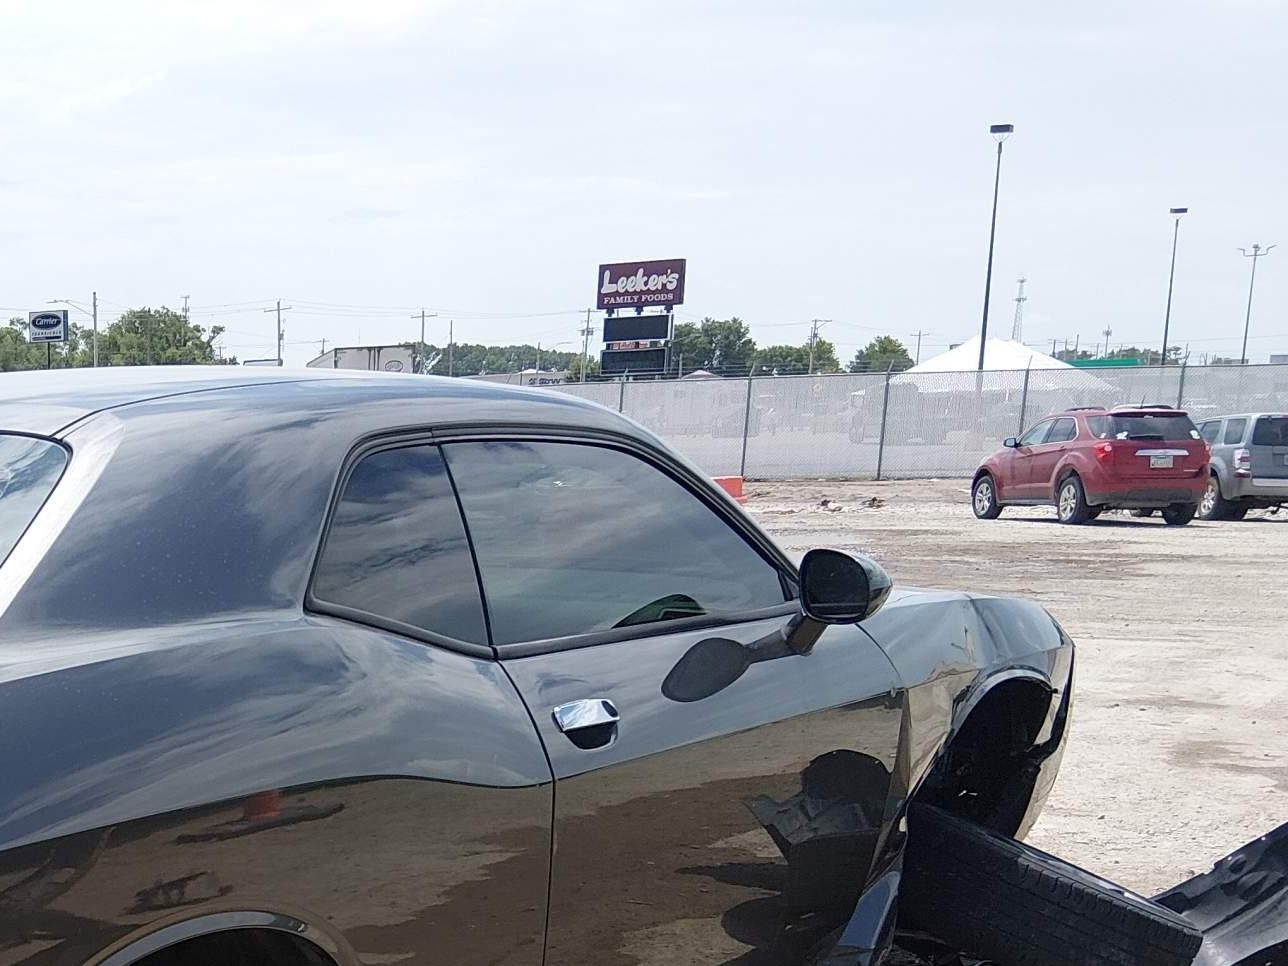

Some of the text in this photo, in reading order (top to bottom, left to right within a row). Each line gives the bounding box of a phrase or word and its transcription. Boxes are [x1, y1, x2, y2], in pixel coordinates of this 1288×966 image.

[600, 268, 679, 294] Leeker's
[603, 293, 674, 305] FAMILY FOODS
